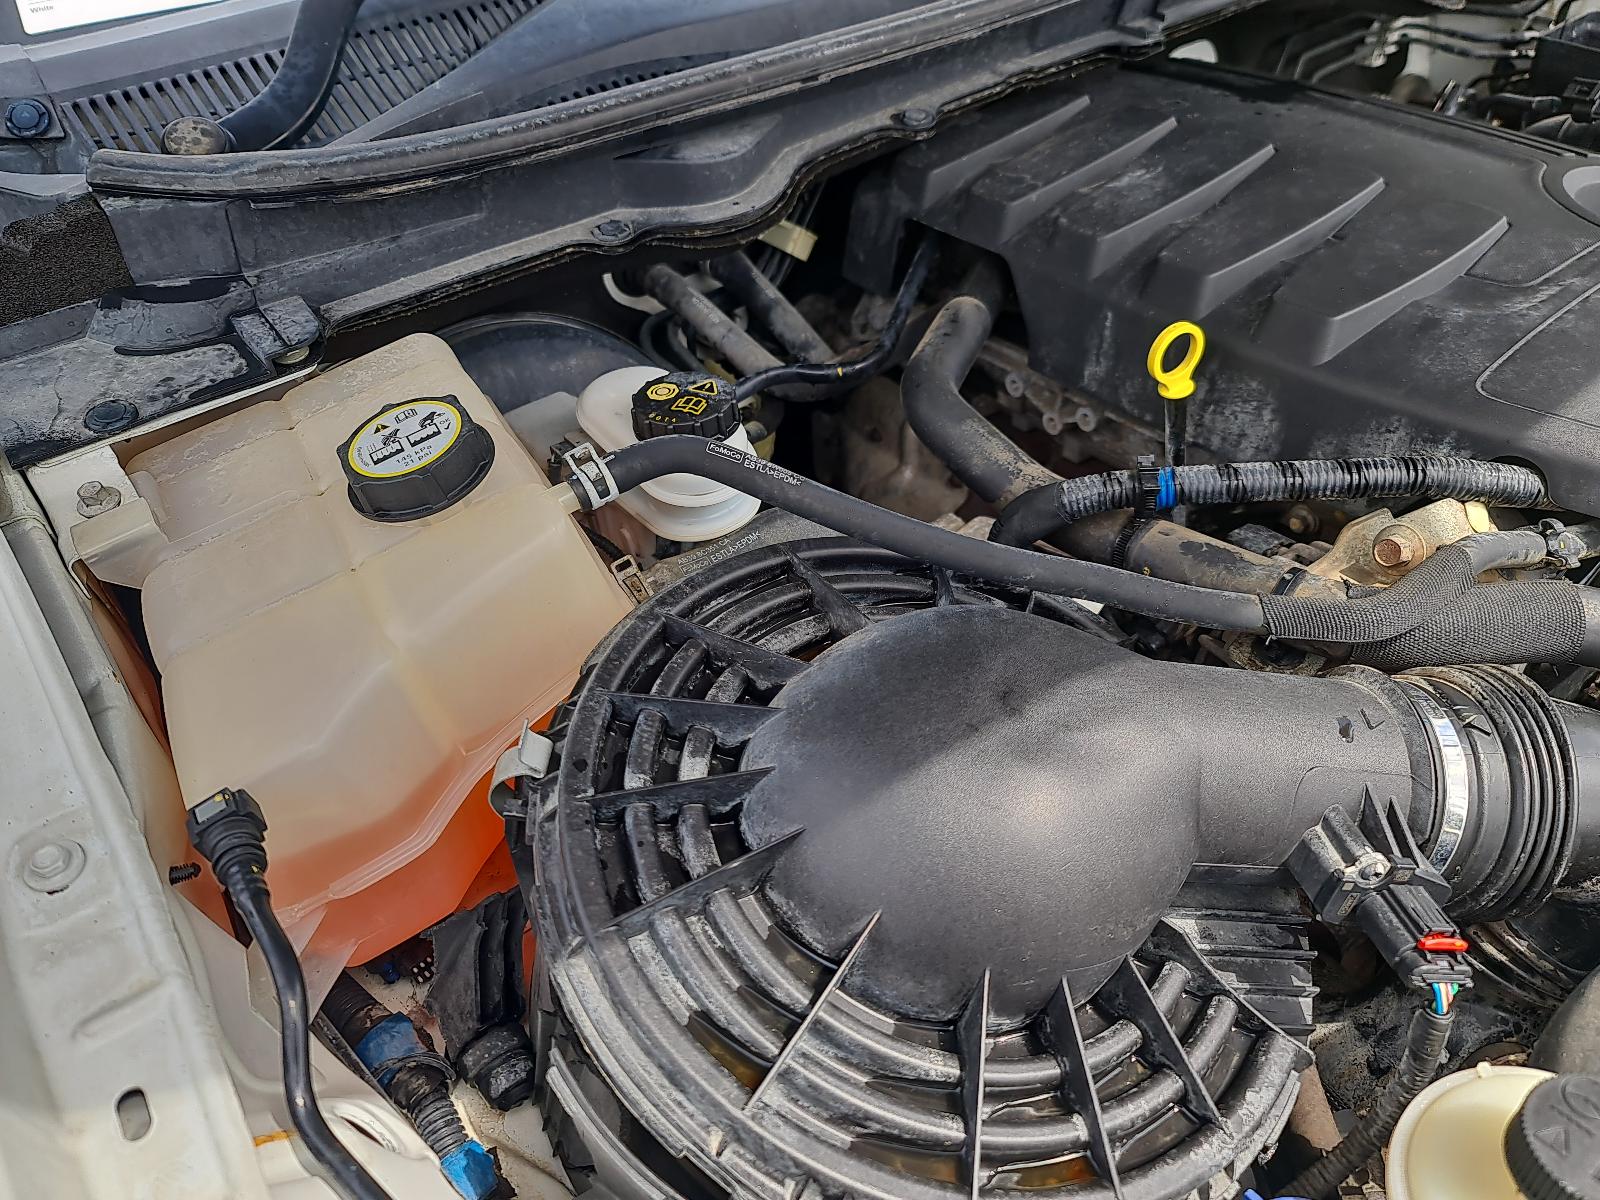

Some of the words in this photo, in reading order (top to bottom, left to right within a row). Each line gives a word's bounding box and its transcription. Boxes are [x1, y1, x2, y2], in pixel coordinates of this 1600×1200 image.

[396, 453, 412, 463] 145
[415, 445, 432, 455] kPa
[709, 443, 741, 460] FoMoCo
[744, 459, 802, 486] ESTLA>EPDM<
[682, 560, 709, 576] FoMoCo
[710, 531, 761, 563] ESTLA>EPDM<
